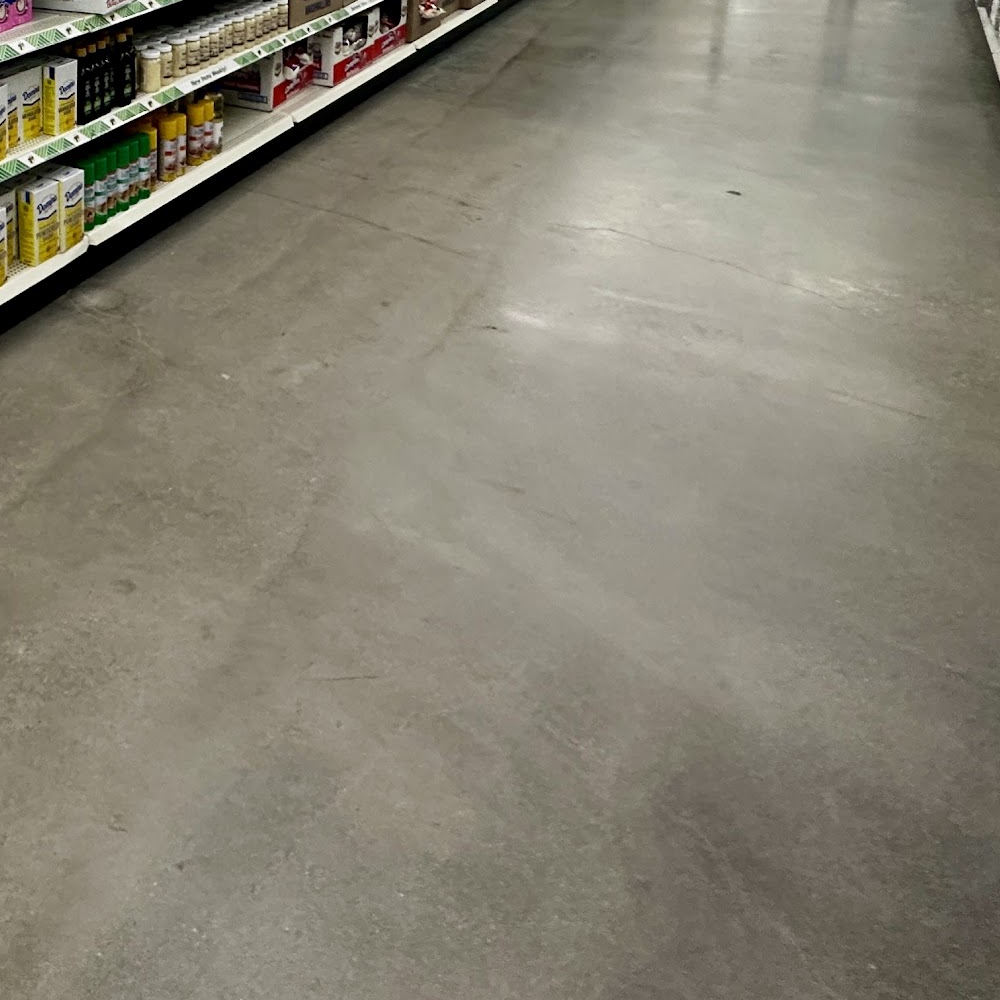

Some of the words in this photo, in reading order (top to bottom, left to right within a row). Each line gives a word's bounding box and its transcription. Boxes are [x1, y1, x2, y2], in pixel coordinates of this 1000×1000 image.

[22, 86, 40, 103] Domino
[59, 80, 75, 95] Domino
[65, 184, 83, 202] Domino
[36, 195, 57, 214] Domino
